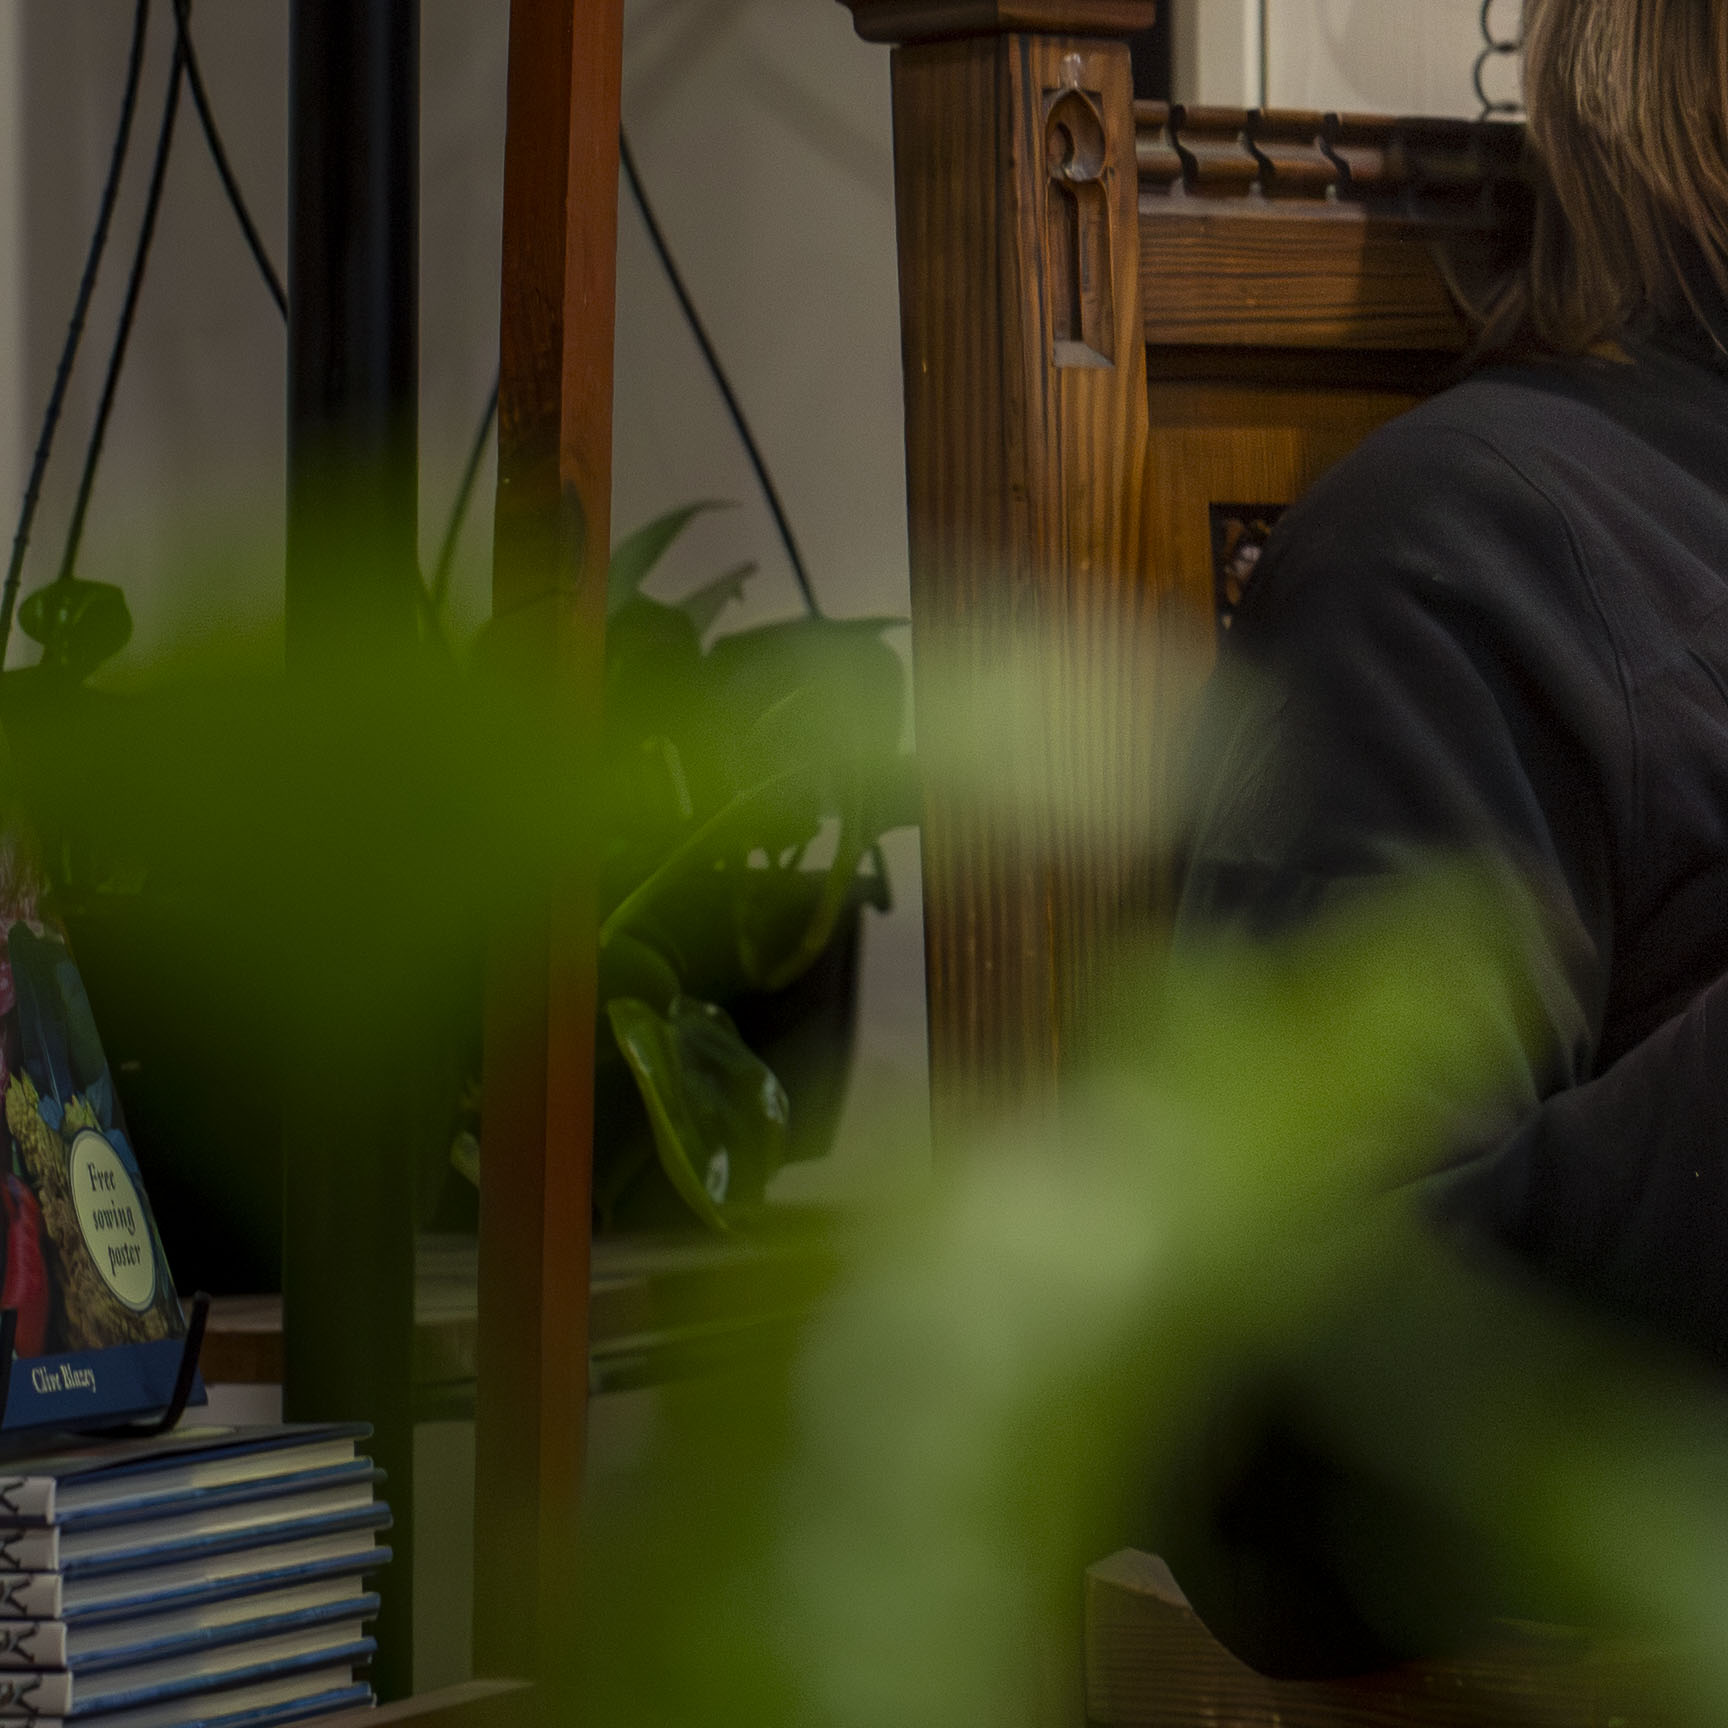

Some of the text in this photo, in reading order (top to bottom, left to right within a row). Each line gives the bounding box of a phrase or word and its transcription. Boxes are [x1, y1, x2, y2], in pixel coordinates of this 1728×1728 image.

[88, 1162, 117, 1193] Free
[93, 1200, 136, 1237] sowing
[108, 1243, 142, 1277] poster
[32, 1365, 60, 1394] Clive
